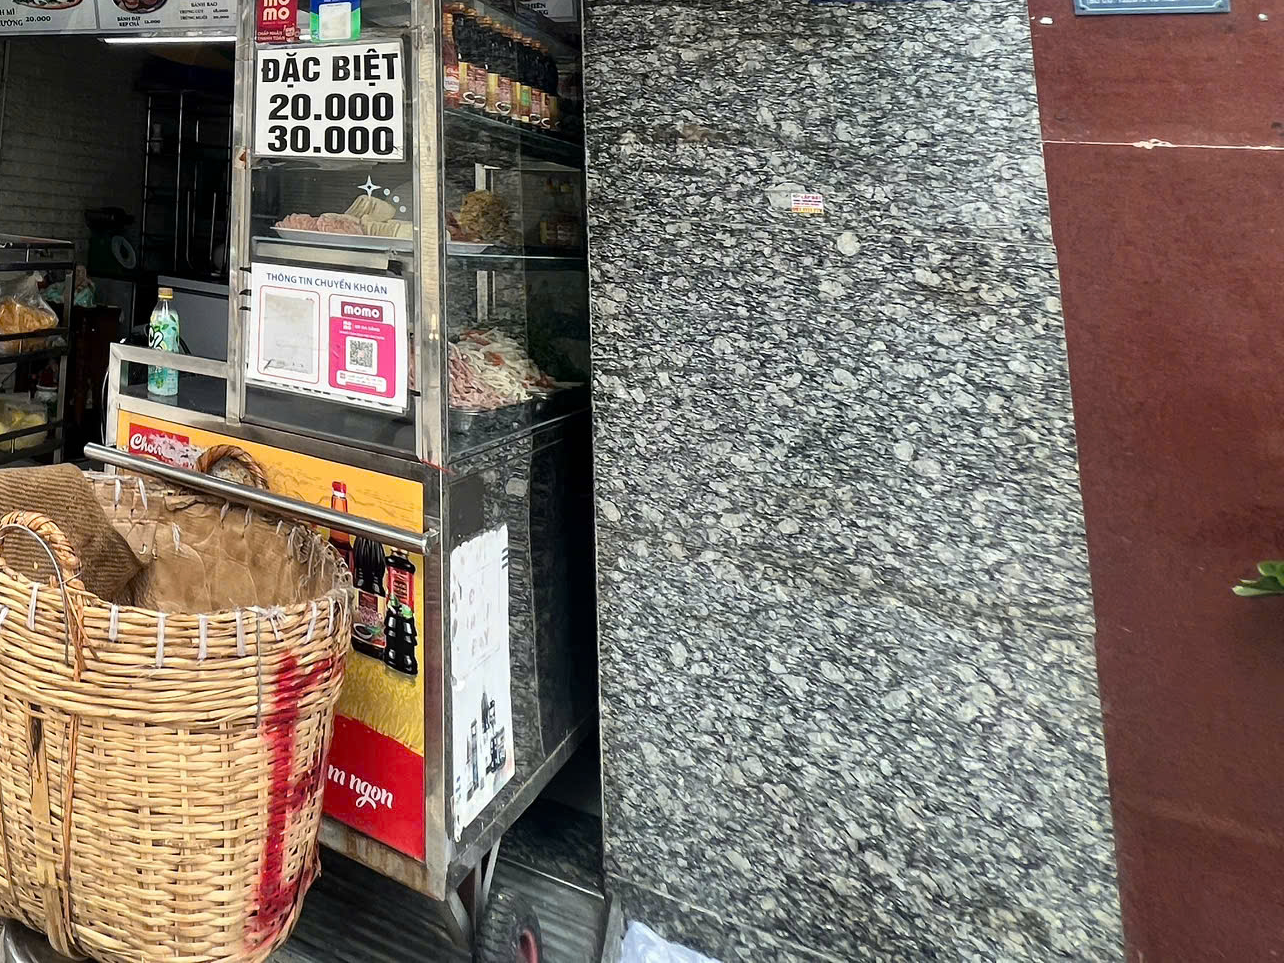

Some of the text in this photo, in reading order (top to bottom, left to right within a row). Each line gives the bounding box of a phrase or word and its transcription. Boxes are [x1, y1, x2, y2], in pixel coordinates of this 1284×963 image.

[261, 48, 398, 88] ĐẶC BIỆT
[268, 92, 394, 121] 20.000
[268, 125, 394, 155] 30.000
[267, 272, 387, 294] THÔNG TIN CHUYỂN KHOẢN
[344, 304, 380, 319] momo
[350, 774, 393, 810] ngon
